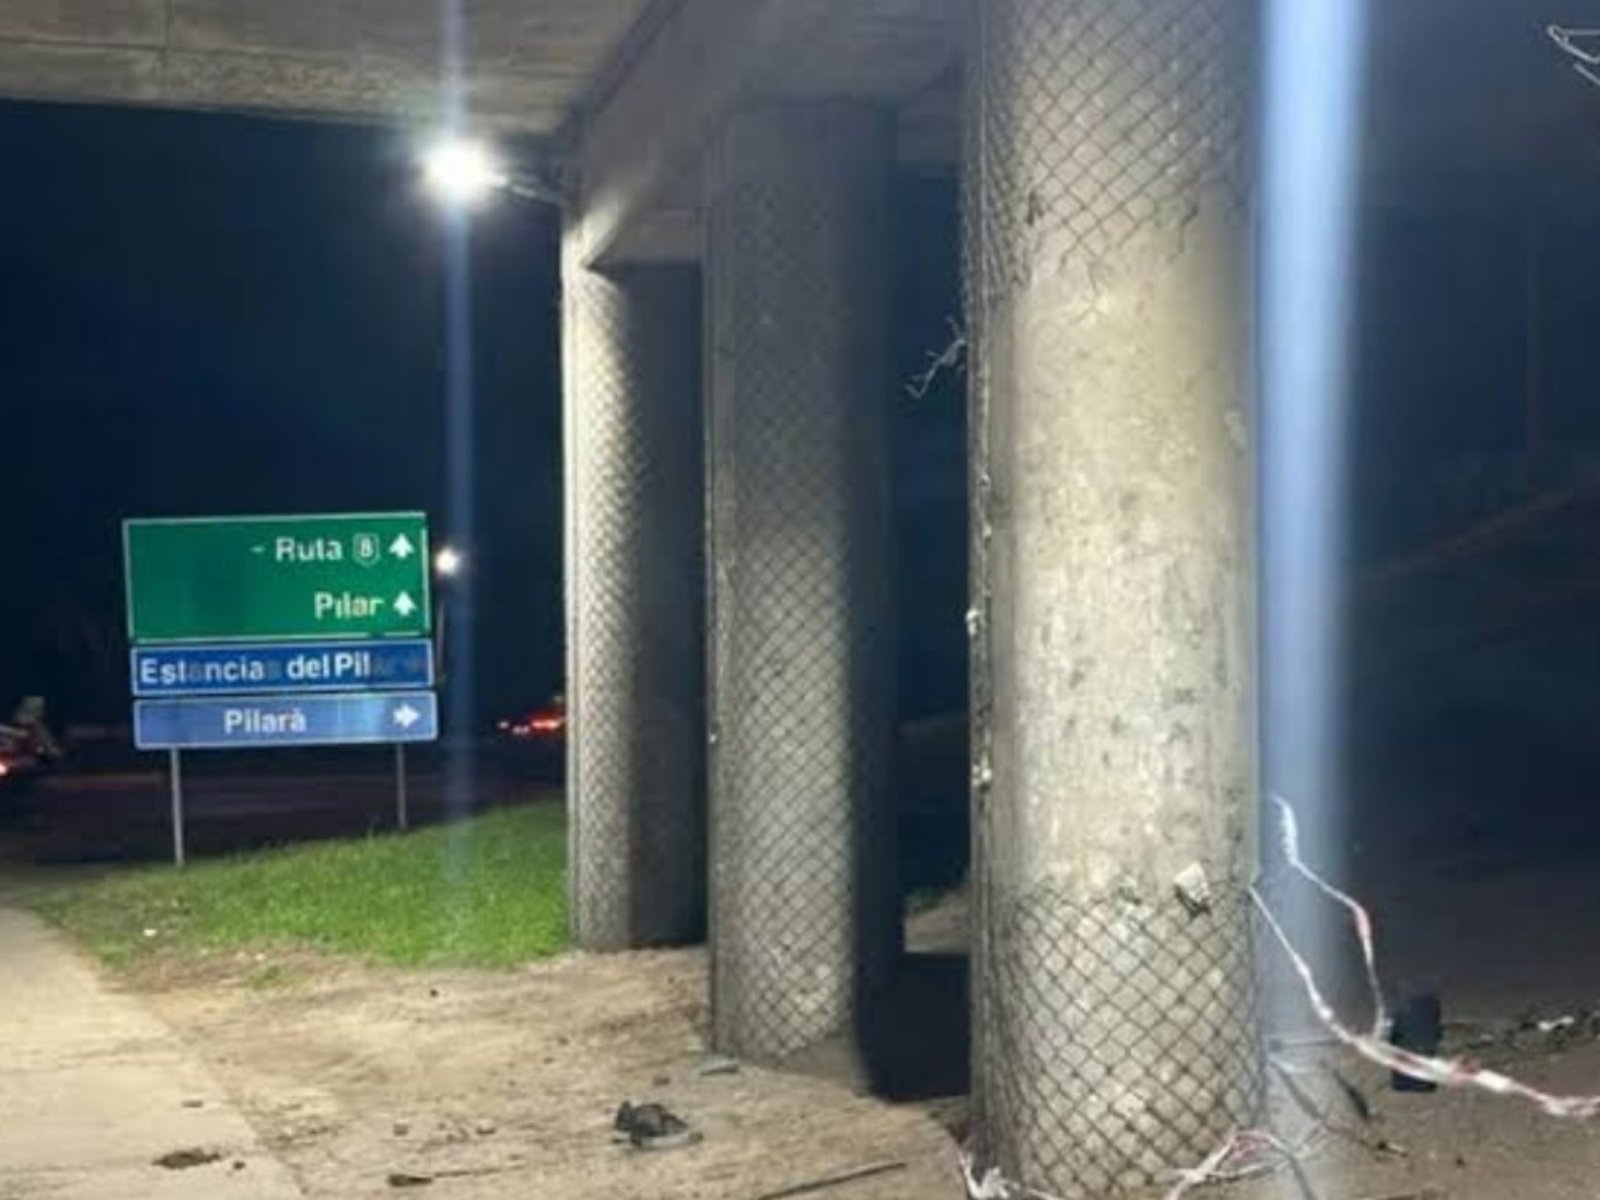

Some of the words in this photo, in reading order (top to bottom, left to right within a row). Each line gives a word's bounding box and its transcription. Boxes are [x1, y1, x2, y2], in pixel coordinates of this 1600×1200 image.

[275, 537, 343, 562] Ruta
[314, 591, 385, 620] Pilar
[140, 658, 281, 684] Estncia
[286, 653, 332, 679] del
